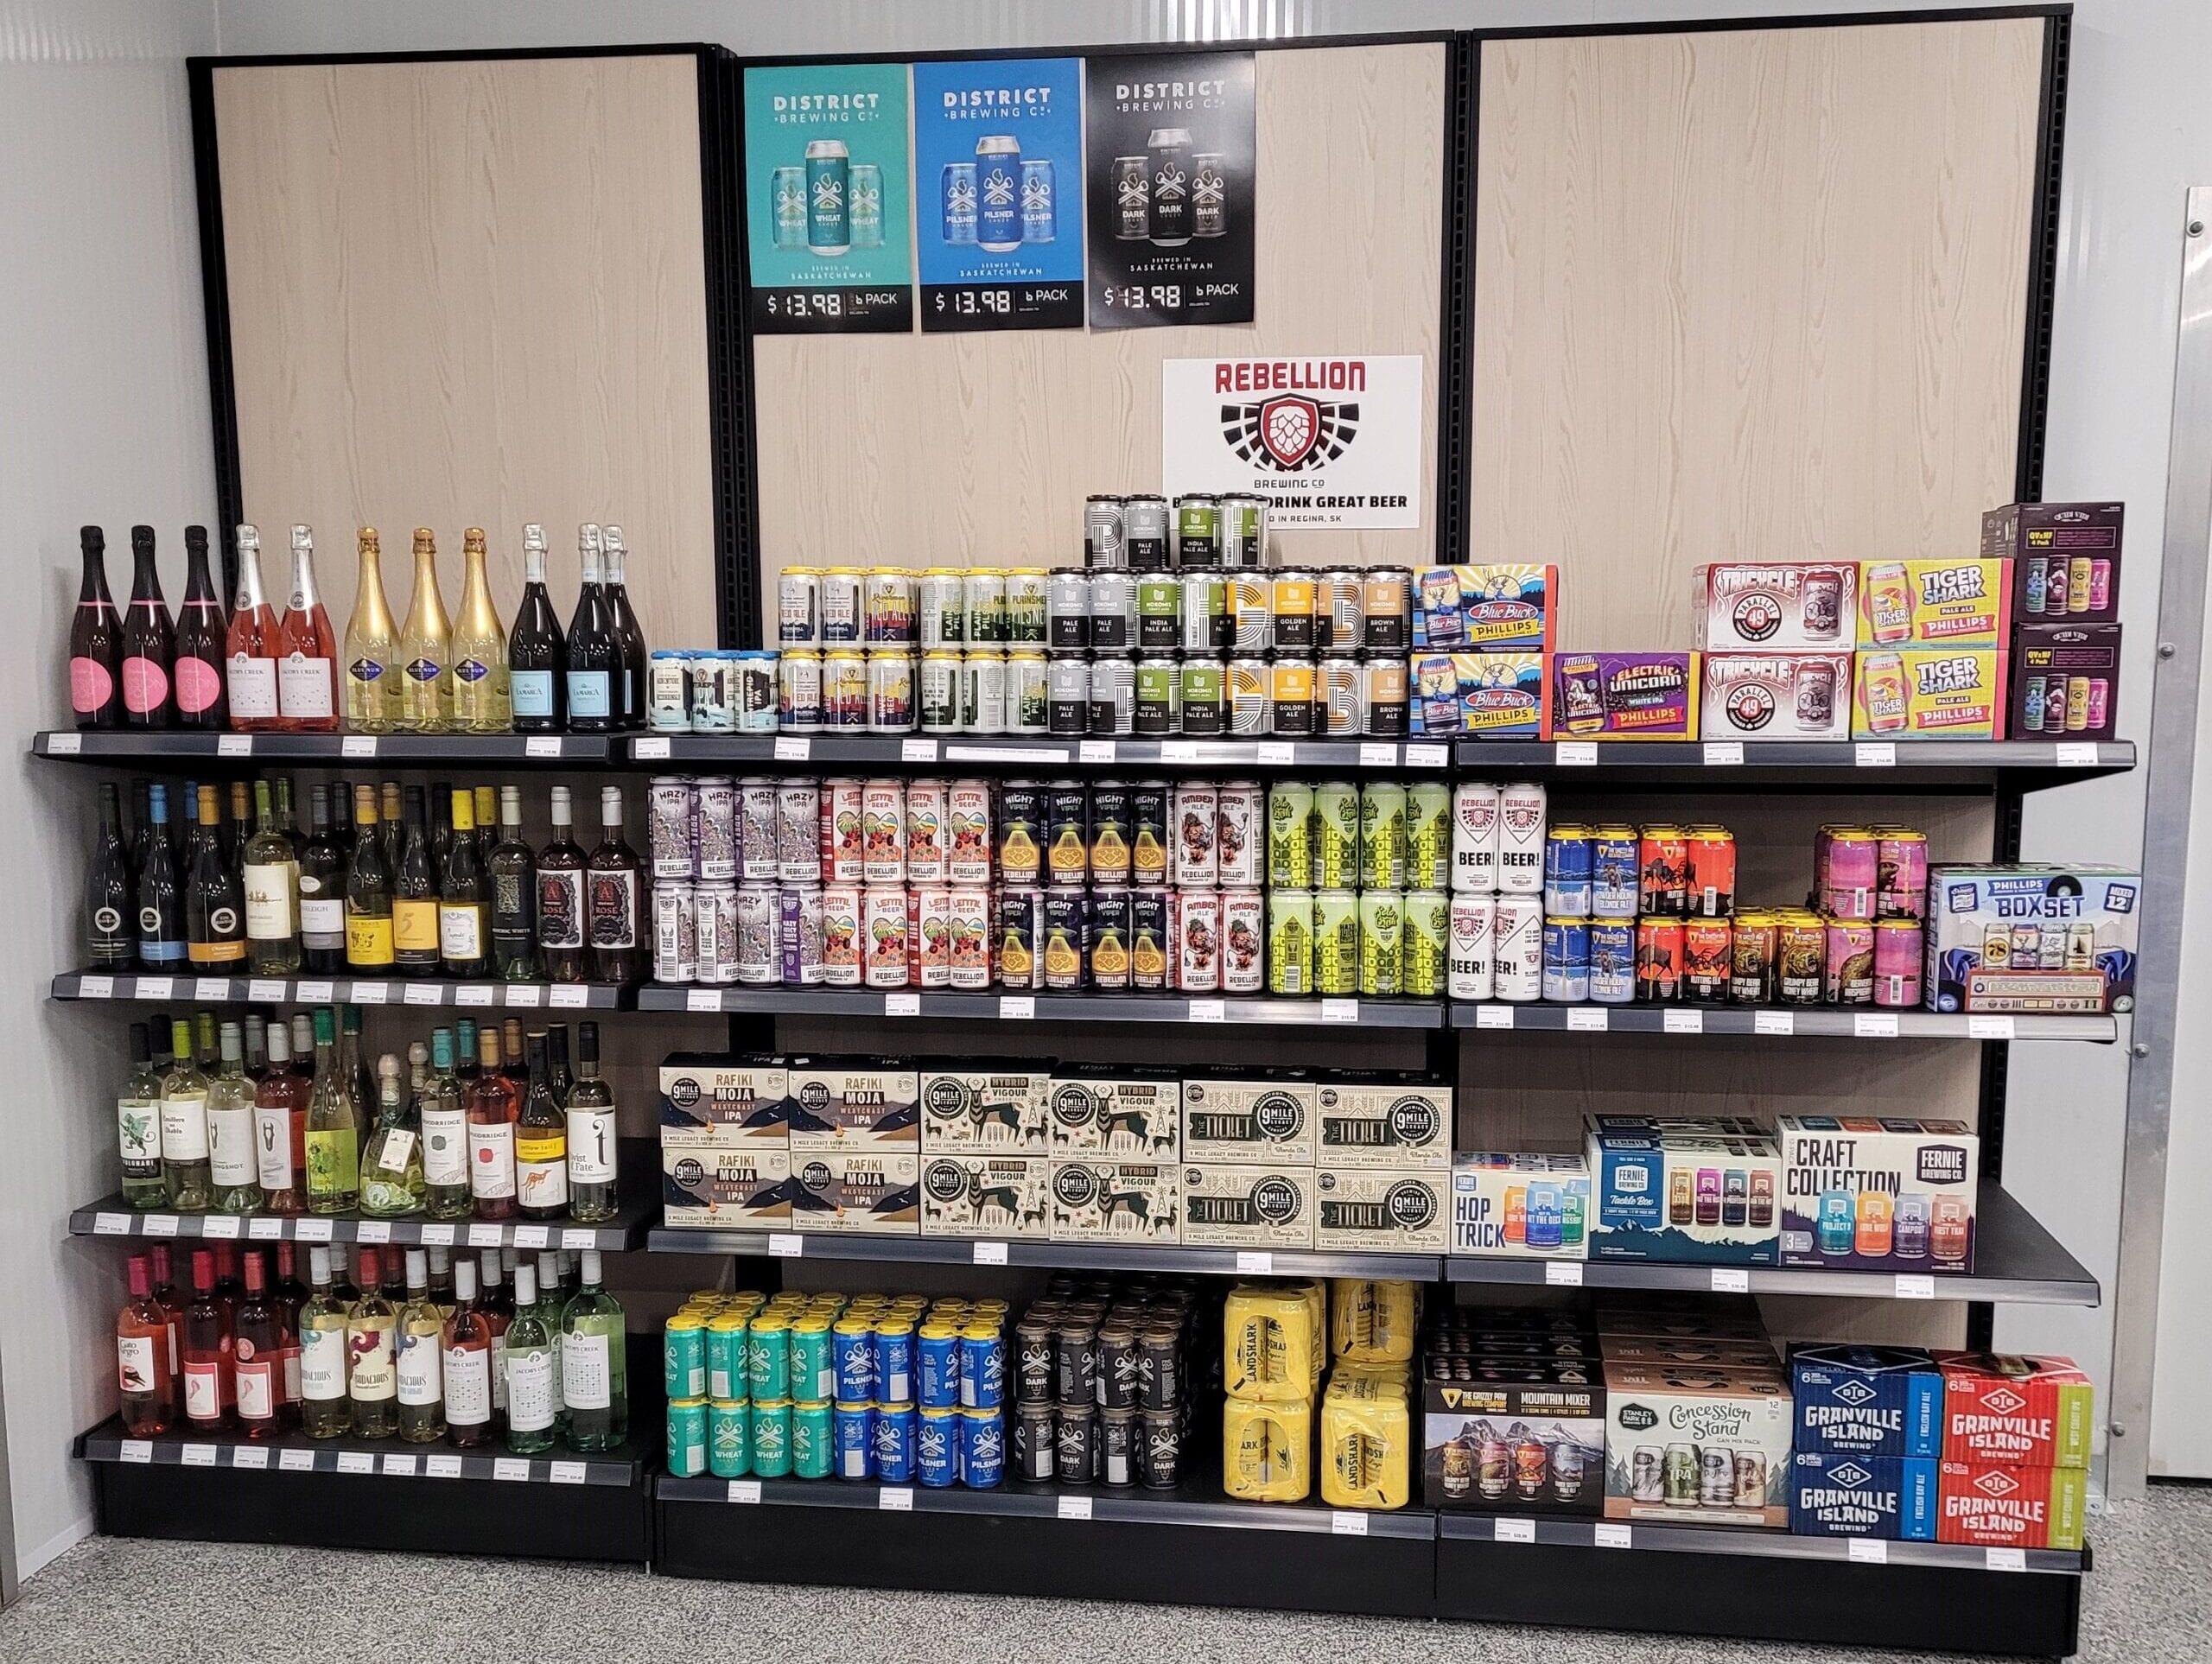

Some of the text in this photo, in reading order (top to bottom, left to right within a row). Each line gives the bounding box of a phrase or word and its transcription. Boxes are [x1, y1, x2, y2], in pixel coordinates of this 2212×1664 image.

[1116, 80, 1224, 99] DISTRICT
[774, 93, 878, 111] DISTRICT
[944, 88, 1051, 106] DISTRICT
[1122, 100, 1193, 112] BREWING
[780, 112, 849, 123] BREWING
[950, 108, 1020, 119] BREWING
[1160, 205, 1182, 213] DARK
[960, 268, 1042, 277] SASKATCHEWAN
[1130, 263, 1213, 272] SASKATCHEWAN
[1206, 283, 1239, 295] PACK
[865, 293, 897, 304] PACK
[955, 289, 1068, 314] 13.98 PACK
[1215, 361, 1366, 393] REBELLION
[1255, 480, 1308, 488] BREWING
[1317, 495, 1365, 508] GREAT
[1370, 495, 1408, 508] BEER
[1721, 570, 1796, 598] TRICYCLE
[1921, 566, 1982, 589] TIGER
[1923, 583, 1986, 605] SHARK
[1479, 606, 1535, 619] Blue Buck
[1738, 598, 1777, 615] PARALLEL
[1748, 610, 1764, 624] 49
[1927, 616, 1987, 632] PHILLIPS
[1477, 621, 1532, 635] PHILLIPS
[1618, 665, 1674, 681] ELECTRIC
[1714, 661, 1789, 688] TRICYCLE
[1916, 657, 1978, 679] TIGER
[1611, 675, 1681, 691] UNICORN
[1918, 674, 1982, 695] SHARK
[1476, 693, 1531, 707] Blue Buck
[1732, 688, 1770, 706] PARALLEL
[1742, 700, 1758, 714] 49
[1923, 707, 1982, 721] PHILLIPS
[1473, 710, 1529, 722] PHILLIPS
[1618, 708, 1675, 721] PHILLIPS
[1005, 794, 1034, 804] NIGHT
[1459, 852, 1495, 866] BEER!
[1182, 870, 1214, 879] REBELLION
[1993, 880, 2044, 891] PHILLIPS
[2107, 897, 2126, 909] 12
[716, 1074, 753, 1086] RAFIKI
[673, 1086, 680, 1098] 9
[716, 1089, 751, 1101] MOJA
[933, 1090, 940, 1105] 9
[725, 1111, 742, 1120] IPA
[1397, 1113, 1428, 1129] 9 MILE
[1331, 1121, 1387, 1143] THE TICKET
[1796, 1139, 1857, 1166] CRAFT
[1922, 1150, 1962, 1169] FERNIE
[575, 1163, 593, 1172] Fate
[1921, 1169, 1951, 1179] BREWING
[1618, 1169, 1644, 1181] FERNIE
[1610, 1195, 1654, 1206] Tackle Box
[1457, 1197, 1491, 1222] HOP
[1456, 1223, 1506, 1248] TRICK
[1897, 1225, 1925, 1234] CAMPOUT
[1246, 1324, 1258, 1382] LANDSHARK
[1026, 1377, 1047, 1386] DARK
[1802, 1372, 1811, 1383] 6
[1948, 1381, 1958, 1391] 6
[1472, 1392, 1493, 1400] GRIZZLY
[1521, 1392, 1591, 1406] MOUNTAIN MIXER
[1669, 1402, 1751, 1430] Concession
[1805, 1406, 1902, 1431] GRANVILLE
[1693, 1420, 1740, 1440] Stand
[1821, 1425, 1884, 1441] ISLAND
[1952, 1413, 2051, 1440] GRANVILLE
[1834, 1441, 1872, 1450] BREWING
[1969, 1432, 2033, 1451] ISLAND
[715, 1451, 743, 1459] WHEAT
[1980, 1451, 2019, 1459] BREWING
[972, 1458, 1001, 1468] PILSNER
[1670, 1470, 1692, 1480] IPA
[1801, 1488, 1897, 1514] GRANVILLE
[1817, 1507, 1879, 1523] ISLAND
[1946, 1496, 2044, 1523] GRANVILLE
[1962, 1515, 2025, 1533] ISLAND
